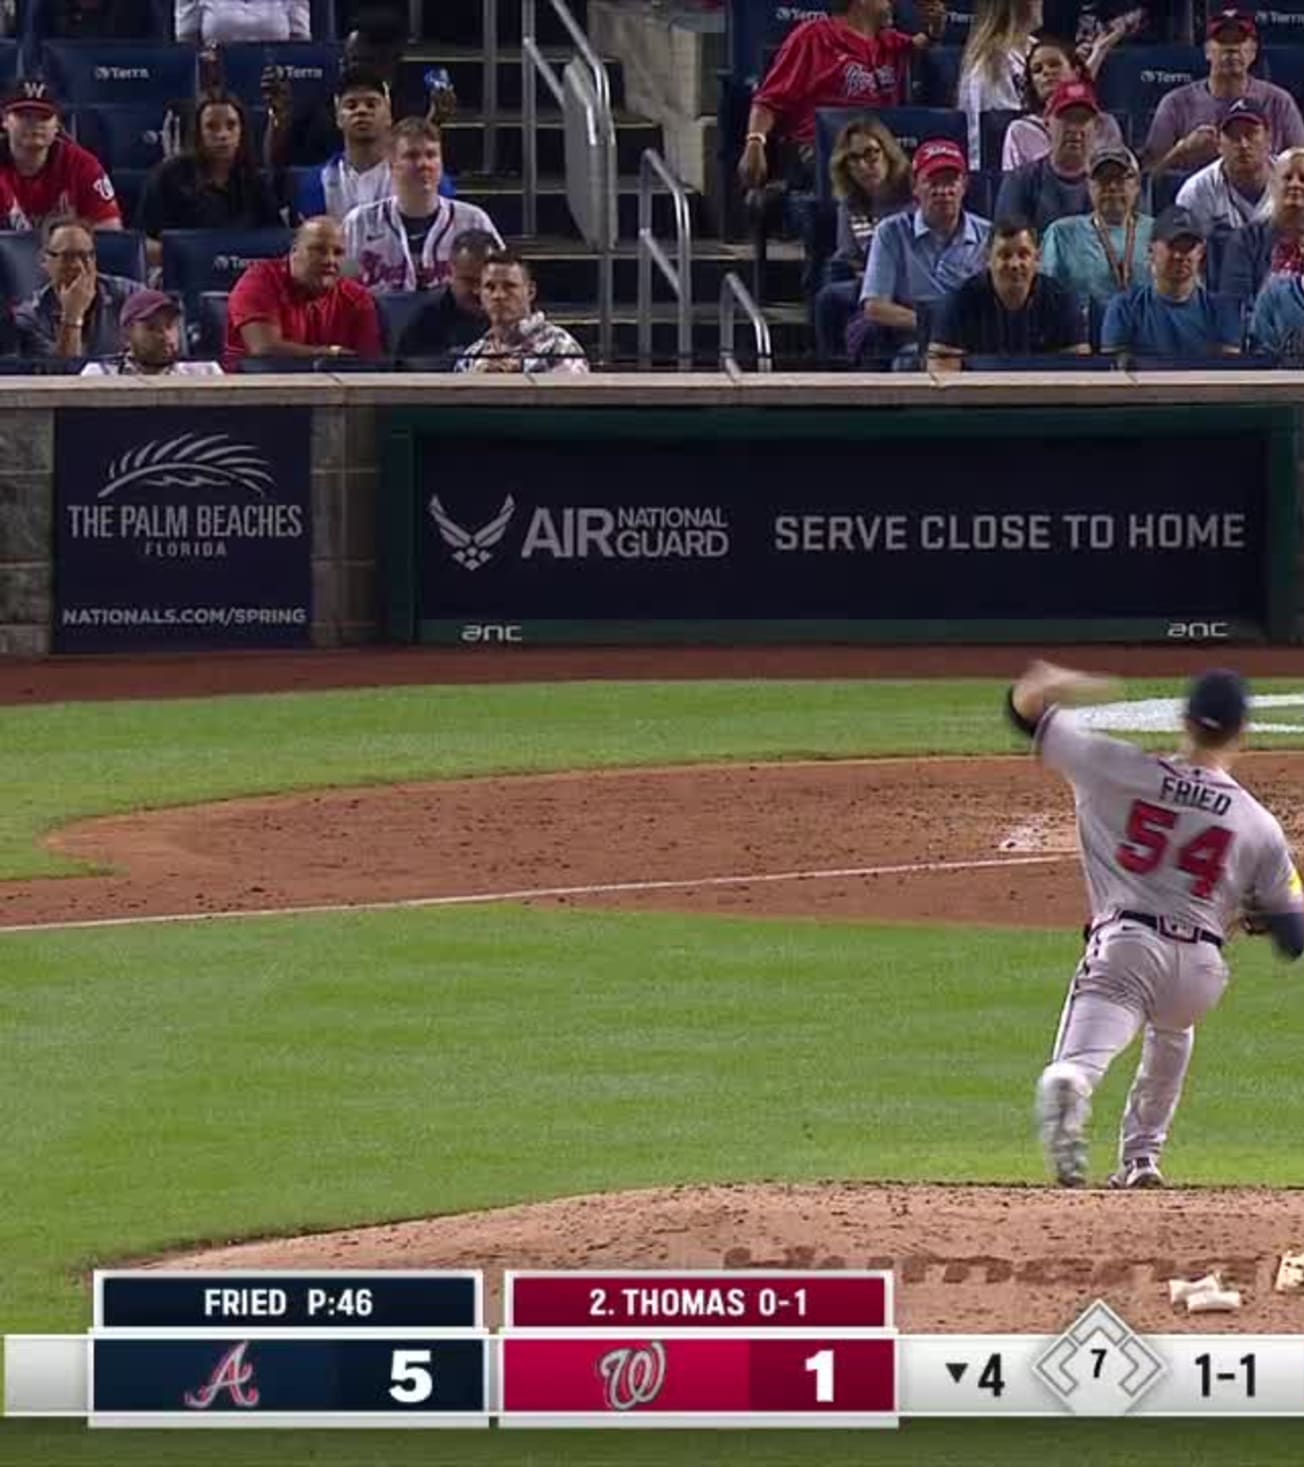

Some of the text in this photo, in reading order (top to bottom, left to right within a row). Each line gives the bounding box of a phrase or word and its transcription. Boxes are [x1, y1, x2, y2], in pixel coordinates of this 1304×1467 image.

[24, 81, 46, 98] W
[68, 504, 303, 538] THE PALM BEACHES
[618, 507, 728, 528] NATIONAL
[521, 507, 617, 558] AIR
[615, 529, 729, 558] GUARD
[774, 514, 1245, 551] SERVE CLOSE TO HOME
[145, 542, 227, 557] FLORIDA
[62, 608, 306, 626] NATIONALS.COM/SPRING
[461, 623, 523, 642] anc
[1167, 622, 1229, 638] anc
[1161, 774, 1233, 817] FRIED
[1115, 798, 1235, 901] 54
